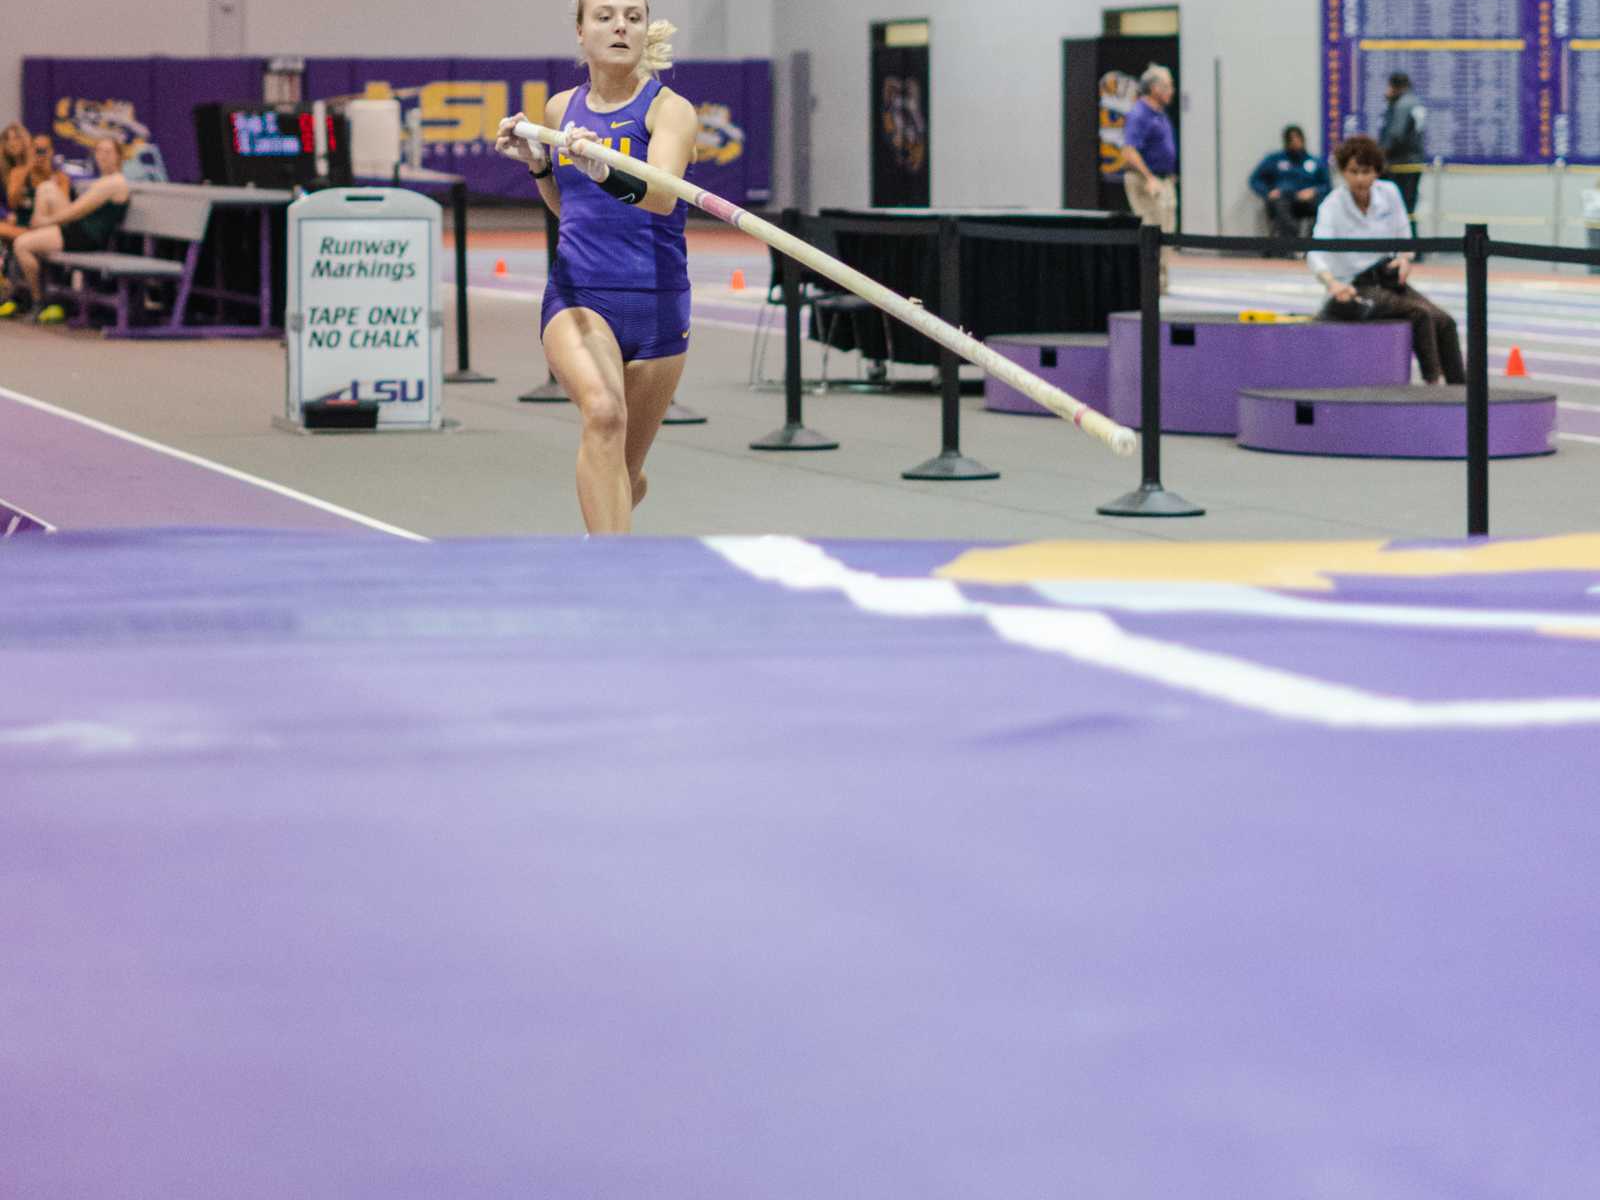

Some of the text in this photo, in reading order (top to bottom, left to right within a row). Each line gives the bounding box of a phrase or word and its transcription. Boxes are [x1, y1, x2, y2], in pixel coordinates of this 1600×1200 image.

[319, 236, 410, 257] Runway
[310, 259, 416, 281] Markings
[307, 306, 423, 326] TAPE ONLY
[308, 330, 420, 349] NO CHALK
